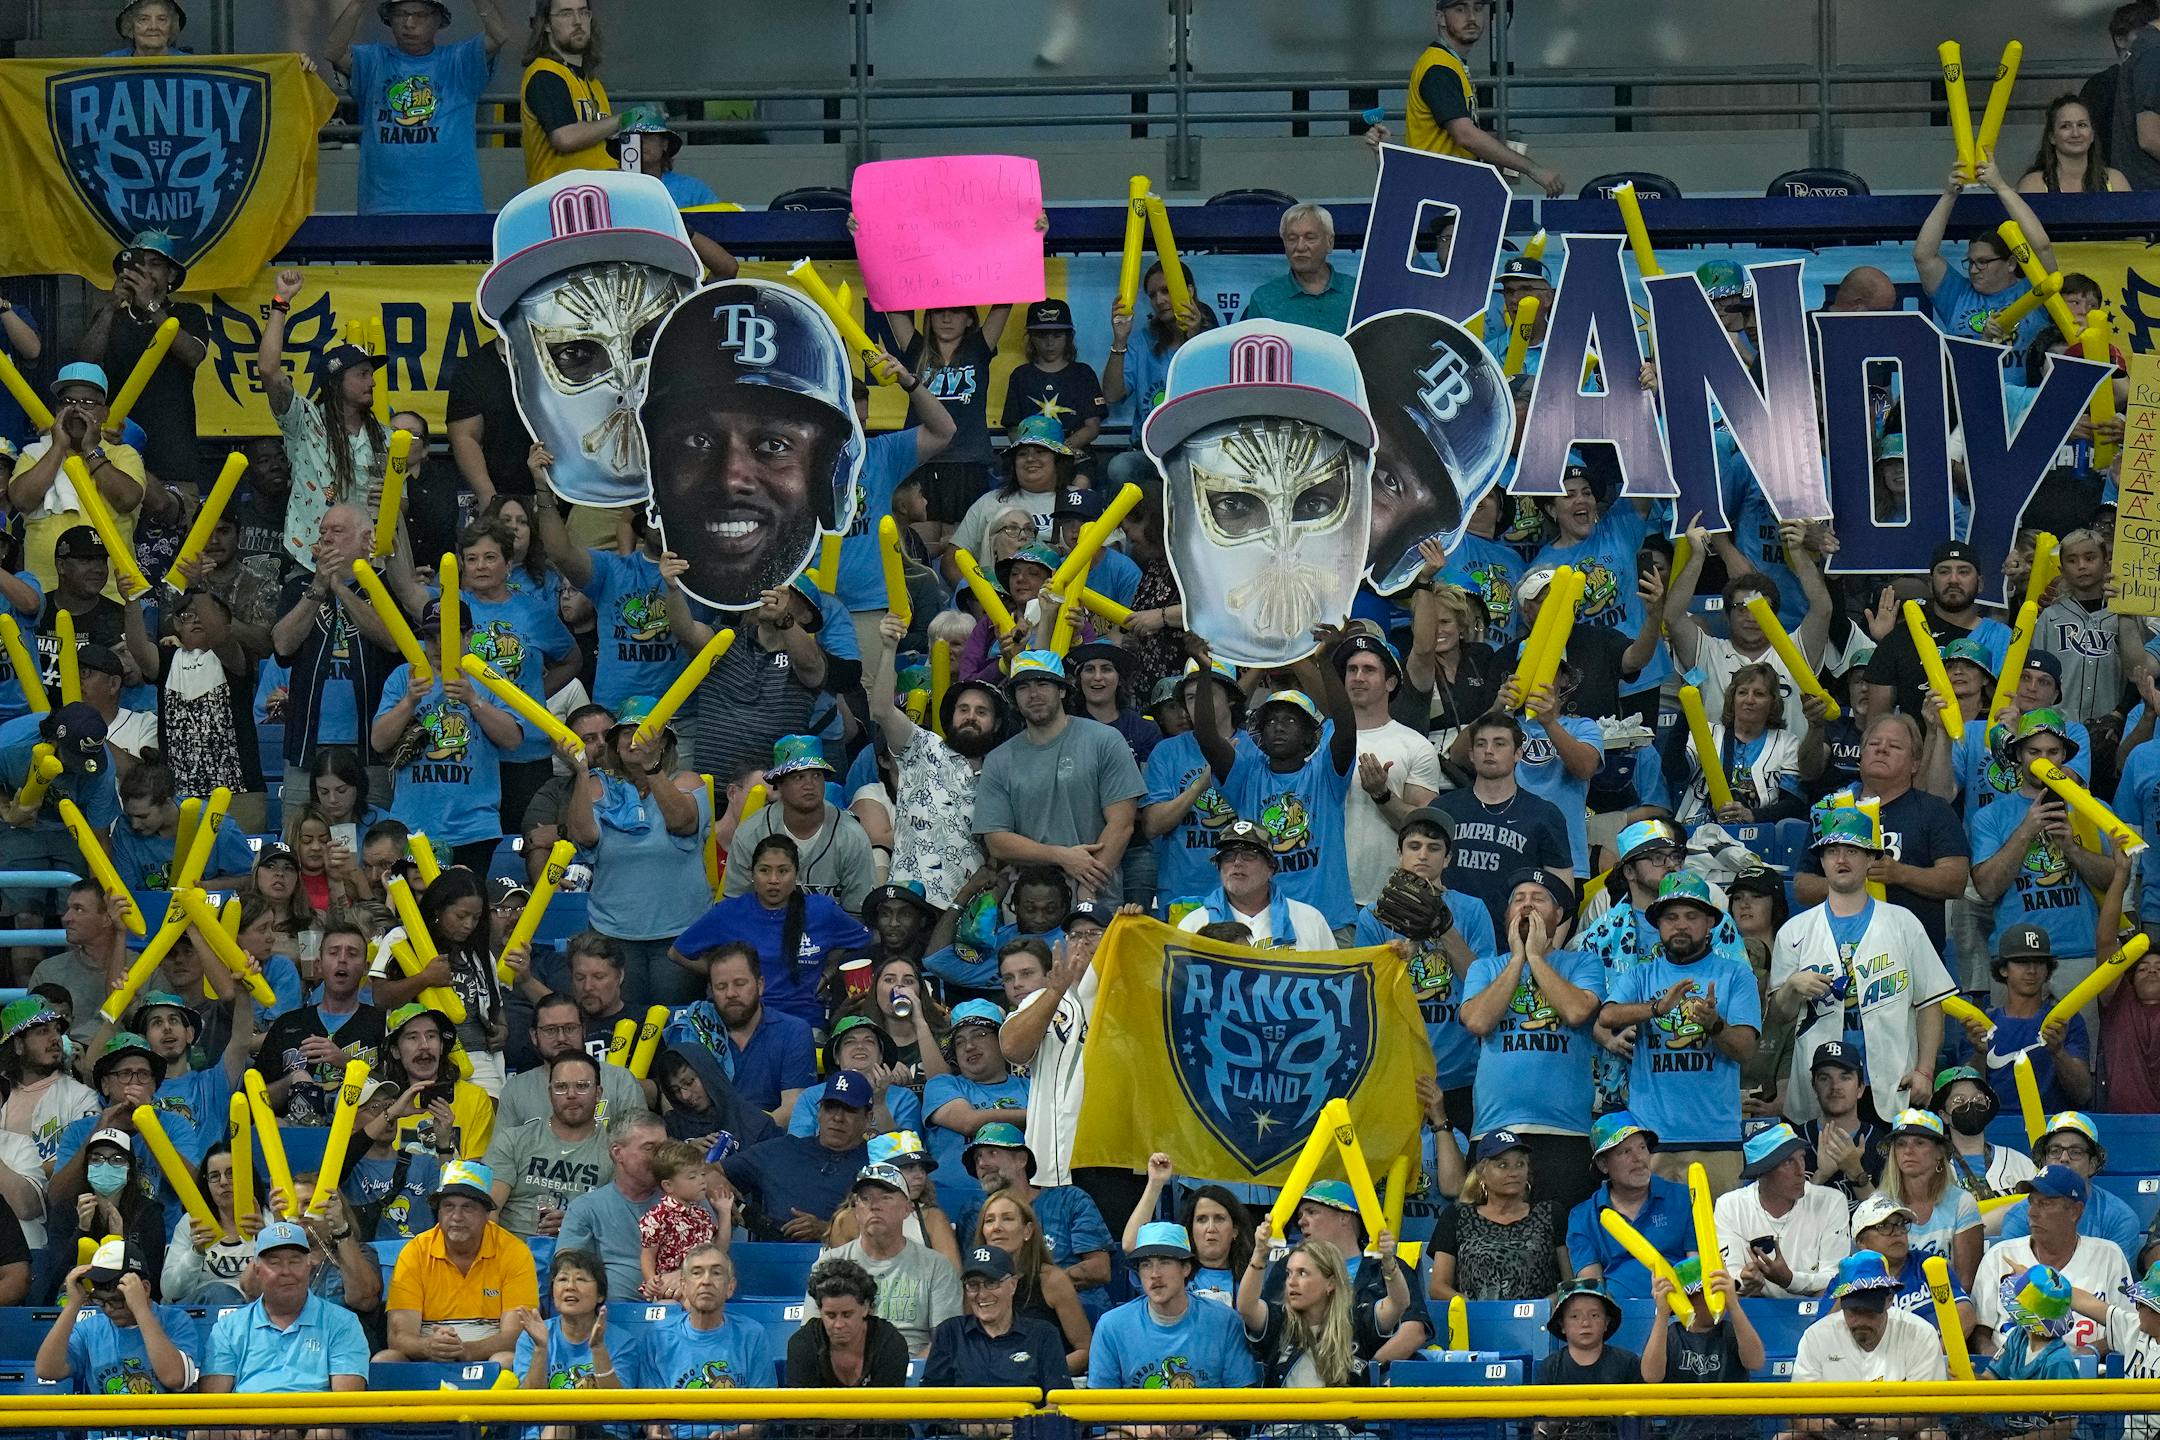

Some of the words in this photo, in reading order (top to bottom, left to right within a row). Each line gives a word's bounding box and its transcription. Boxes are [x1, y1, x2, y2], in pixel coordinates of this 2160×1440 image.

[70, 78, 252, 147] RANDY
[381, 127, 438, 144] RANDY
[148, 140, 171, 155] 56
[130, 191, 193, 221] LAND
[1511, 262, 1523, 272] TB
[1217, 293, 1240, 309] 56
[712, 304, 779, 367] TB
[1413, 341, 1474, 421] TB
[2135, 411, 2156, 428] A+
[2133, 432, 2153, 450] A+
[2133, 451, 2154, 470] A+
[2130, 472, 2153, 490] A+
[1068, 492, 1083, 505] TB
[2126, 495, 2149, 518] A+
[89, 531, 103, 545] LA
[1760, 525, 1777, 539] DE
[2123, 580, 2160, 612] play
[619, 643, 681, 661] RANDY
[774, 653, 789, 668] TB
[1519, 731, 1557, 760] AY
[411, 764, 473, 784] RANDY
[273, 842, 291, 853] TB
[1186, 830, 1221, 849] RAN
[1497, 826, 1528, 855] BAY
[1457, 849, 1501, 872] RAYS
[499, 877, 518, 888] TB
[2016, 874, 2033, 891] DE
[2022, 888, 2081, 912] RANDY
[800, 932, 811, 946] A
[1184, 964, 1356, 1027] RANDY
[1419, 1004, 1460, 1025] NDY
[1262, 1024, 1286, 1041] 56
[1502, 1033, 1569, 1053] RANDY
[1825, 1042, 1842, 1056] TB
[1652, 1052, 1716, 1073] RANDY
[835, 1075, 849, 1091] LA
[1232, 1067, 1302, 1104] LAND
[1495, 1132, 1516, 1143] TB
[529, 1156, 600, 1186] RAYS
[525, 1174, 580, 1193] BASEBALL
[1403, 1200, 1441, 1218] NDY
[276, 1224, 292, 1239] TB
[974, 1248, 990, 1262] TB
[1679, 1350, 1721, 1376] RYS
